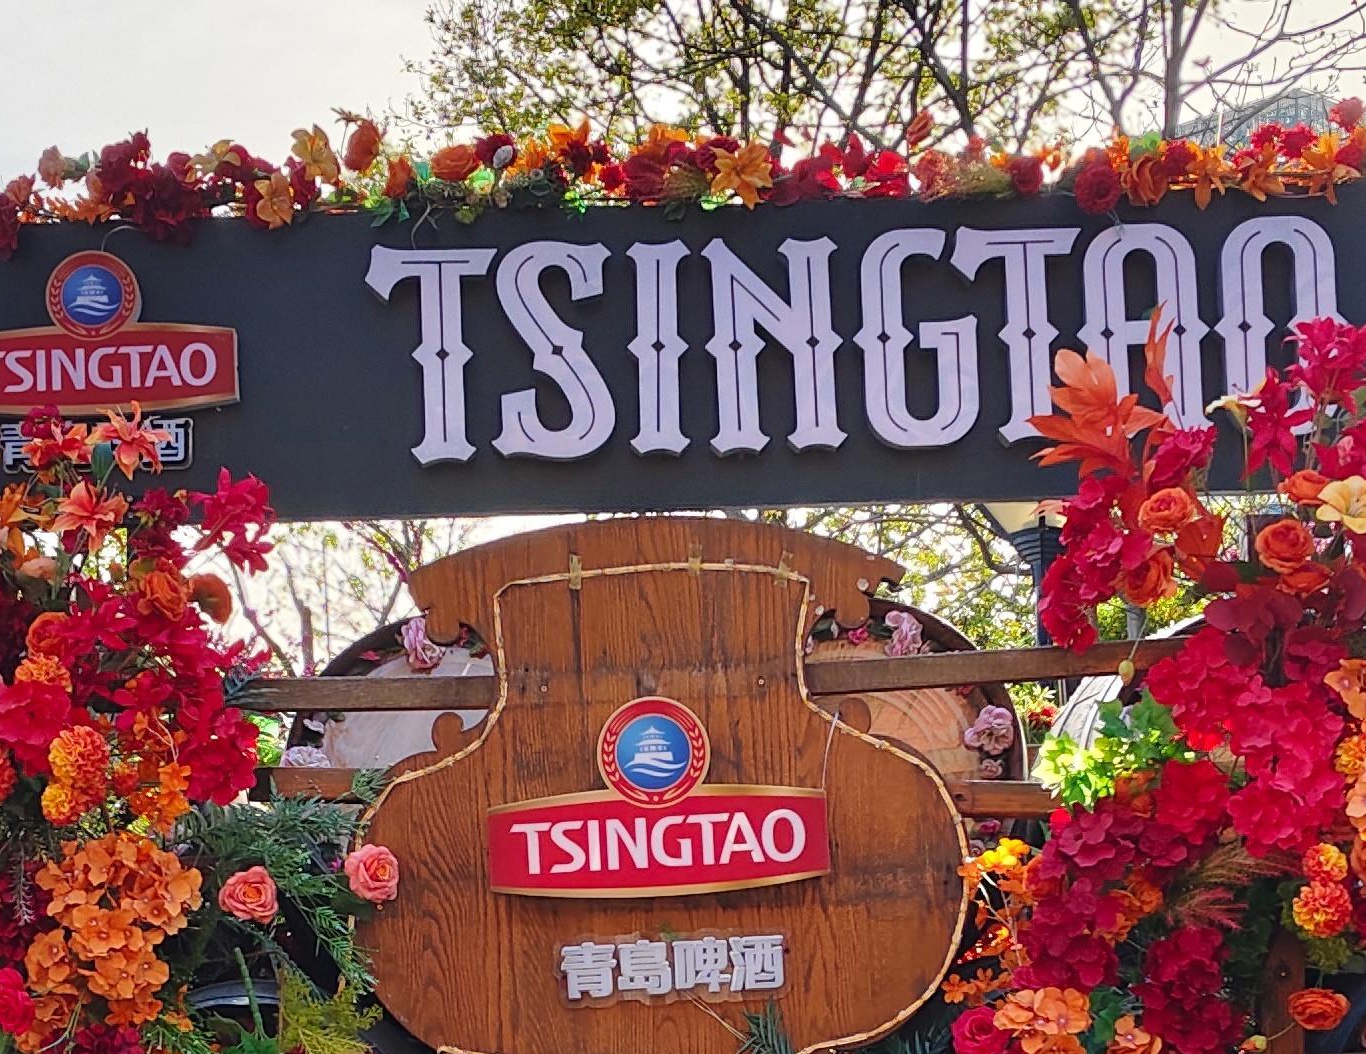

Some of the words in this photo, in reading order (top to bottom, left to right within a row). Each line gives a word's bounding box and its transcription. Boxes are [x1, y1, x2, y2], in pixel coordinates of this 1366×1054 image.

[364, 216, 1349, 466] TSINGTAO
[511, 808, 805, 875] TSINGTAO
[560, 934, 785, 999] 青島啤酒
